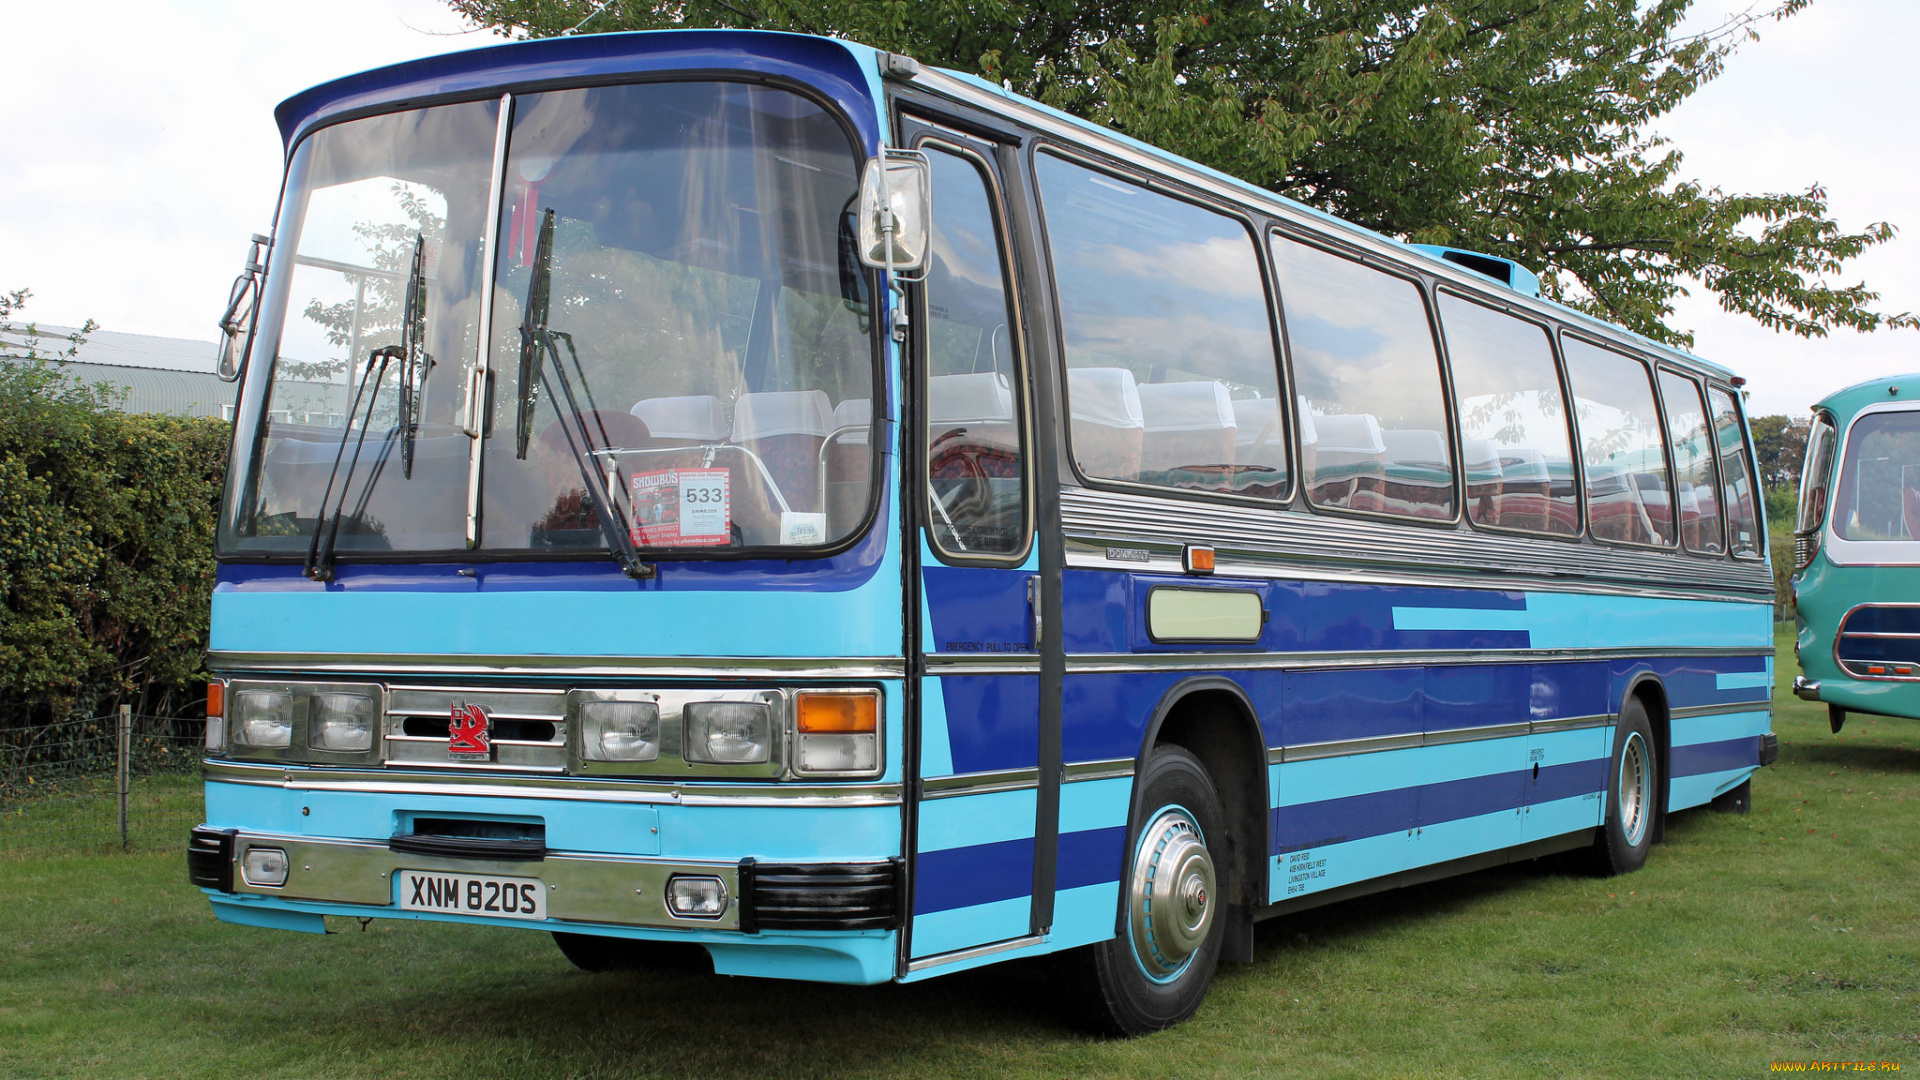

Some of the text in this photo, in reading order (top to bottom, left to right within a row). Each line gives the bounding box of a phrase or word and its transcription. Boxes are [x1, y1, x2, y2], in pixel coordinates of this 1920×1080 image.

[634, 472, 678, 488] SHOWBUS
[686, 488, 722, 503] 533
[1109, 550, 1149, 560] DOMINANT
[946, 642, 1030, 652] EMERGENCY PULL TO OPEN
[1290, 852, 1310, 863] DAVID REID
[1297, 861, 1315, 871] KIRKFIELD
[1316, 859, 1327, 867] WEST
[1288, 869, 1326, 884] LIVINGSTON VILLAGE
[411, 876, 536, 914] XNM 820S
